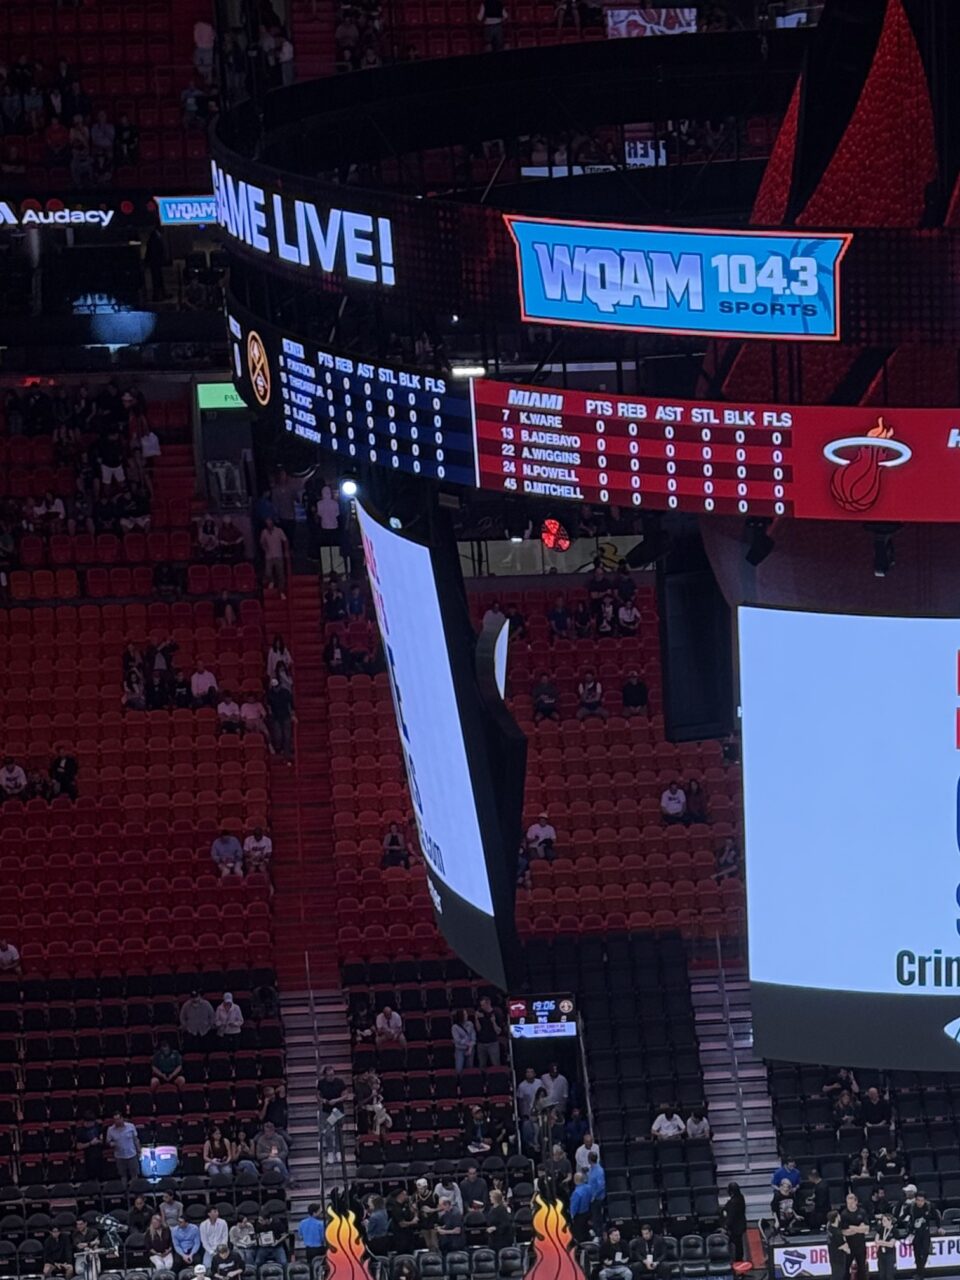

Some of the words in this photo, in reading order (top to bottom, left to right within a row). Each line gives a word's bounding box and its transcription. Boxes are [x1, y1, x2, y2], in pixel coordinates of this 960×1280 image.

[22, 208, 115, 226] Audacy
[166, 202, 218, 220] WQAM
[272, 193, 396, 286] LIVE!
[533, 242, 704, 313] WQAM
[711, 253, 819, 297] 104.3
[719, 300, 818, 317] SPORTS
[335, 356, 354, 374] REB
[357, 362, 375, 379] AST
[378, 368, 398, 385] STL
[398, 372, 421, 390] BLK
[424, 377, 446, 394] FLS
[502, 409, 510, 422] 7
[519, 412, 563, 429] K.WARE
[508, 389, 564, 411] MIAMI
[586, 399, 613, 416] PTS
[617, 402, 647, 419] REB
[655, 405, 683, 422] AST
[691, 408, 719, 425] STL
[724, 410, 756, 426] BLK
[763, 411, 793, 428] FLS
[500, 427, 514, 440] 13
[520, 429, 581, 448] B.ADEBAYO
[501, 443, 515, 457] 22
[521, 446, 581, 465] A.WIGGINS
[503, 460, 516, 474] 24
[522, 463, 579, 482] N.POWELL
[504, 477, 517, 491] 45
[524, 480, 584, 499] D.MITCHELL
